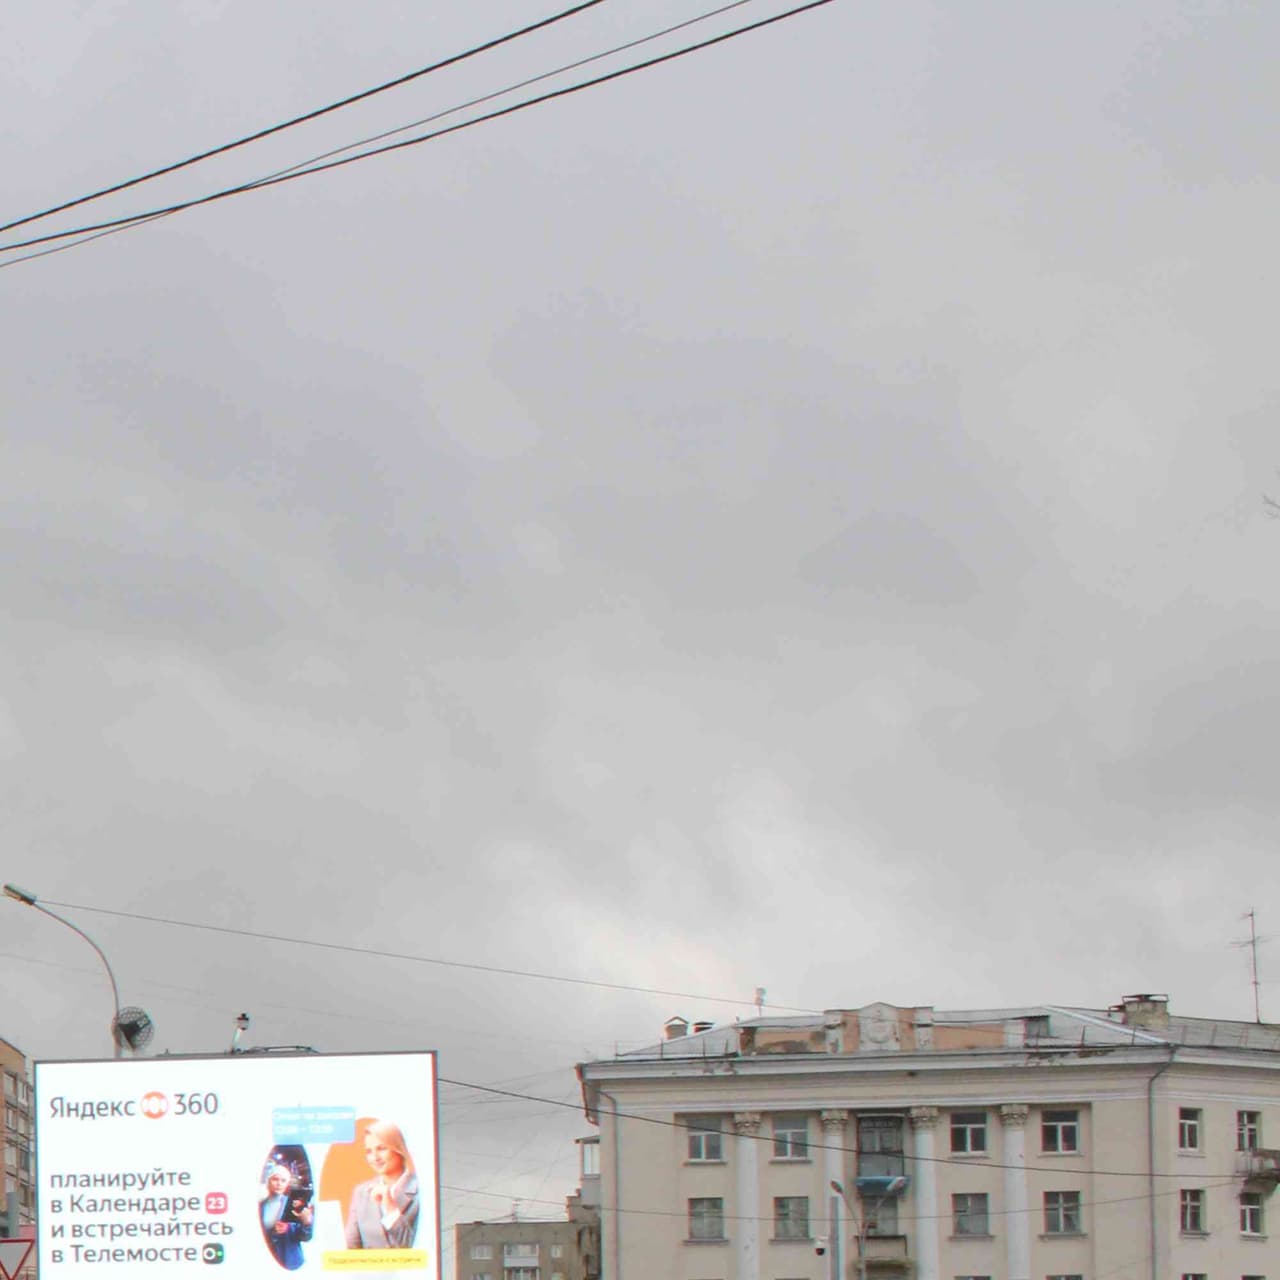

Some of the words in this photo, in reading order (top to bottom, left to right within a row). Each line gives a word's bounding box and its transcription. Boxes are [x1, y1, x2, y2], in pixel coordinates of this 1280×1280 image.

[50, 1096, 137, 1121] Яндекс
[174, 1092, 220, 1117] 360
[49, 1167, 192, 1192] планируйте
[50, 1199, 64, 1214] в
[70, 1194, 201, 1216] Календаре
[50, 1224, 65, 1238] и
[71, 1217, 235, 1242] встречайтесь
[51, 1249, 64, 1263] в
[70, 1244, 198, 1264] Телемосте
